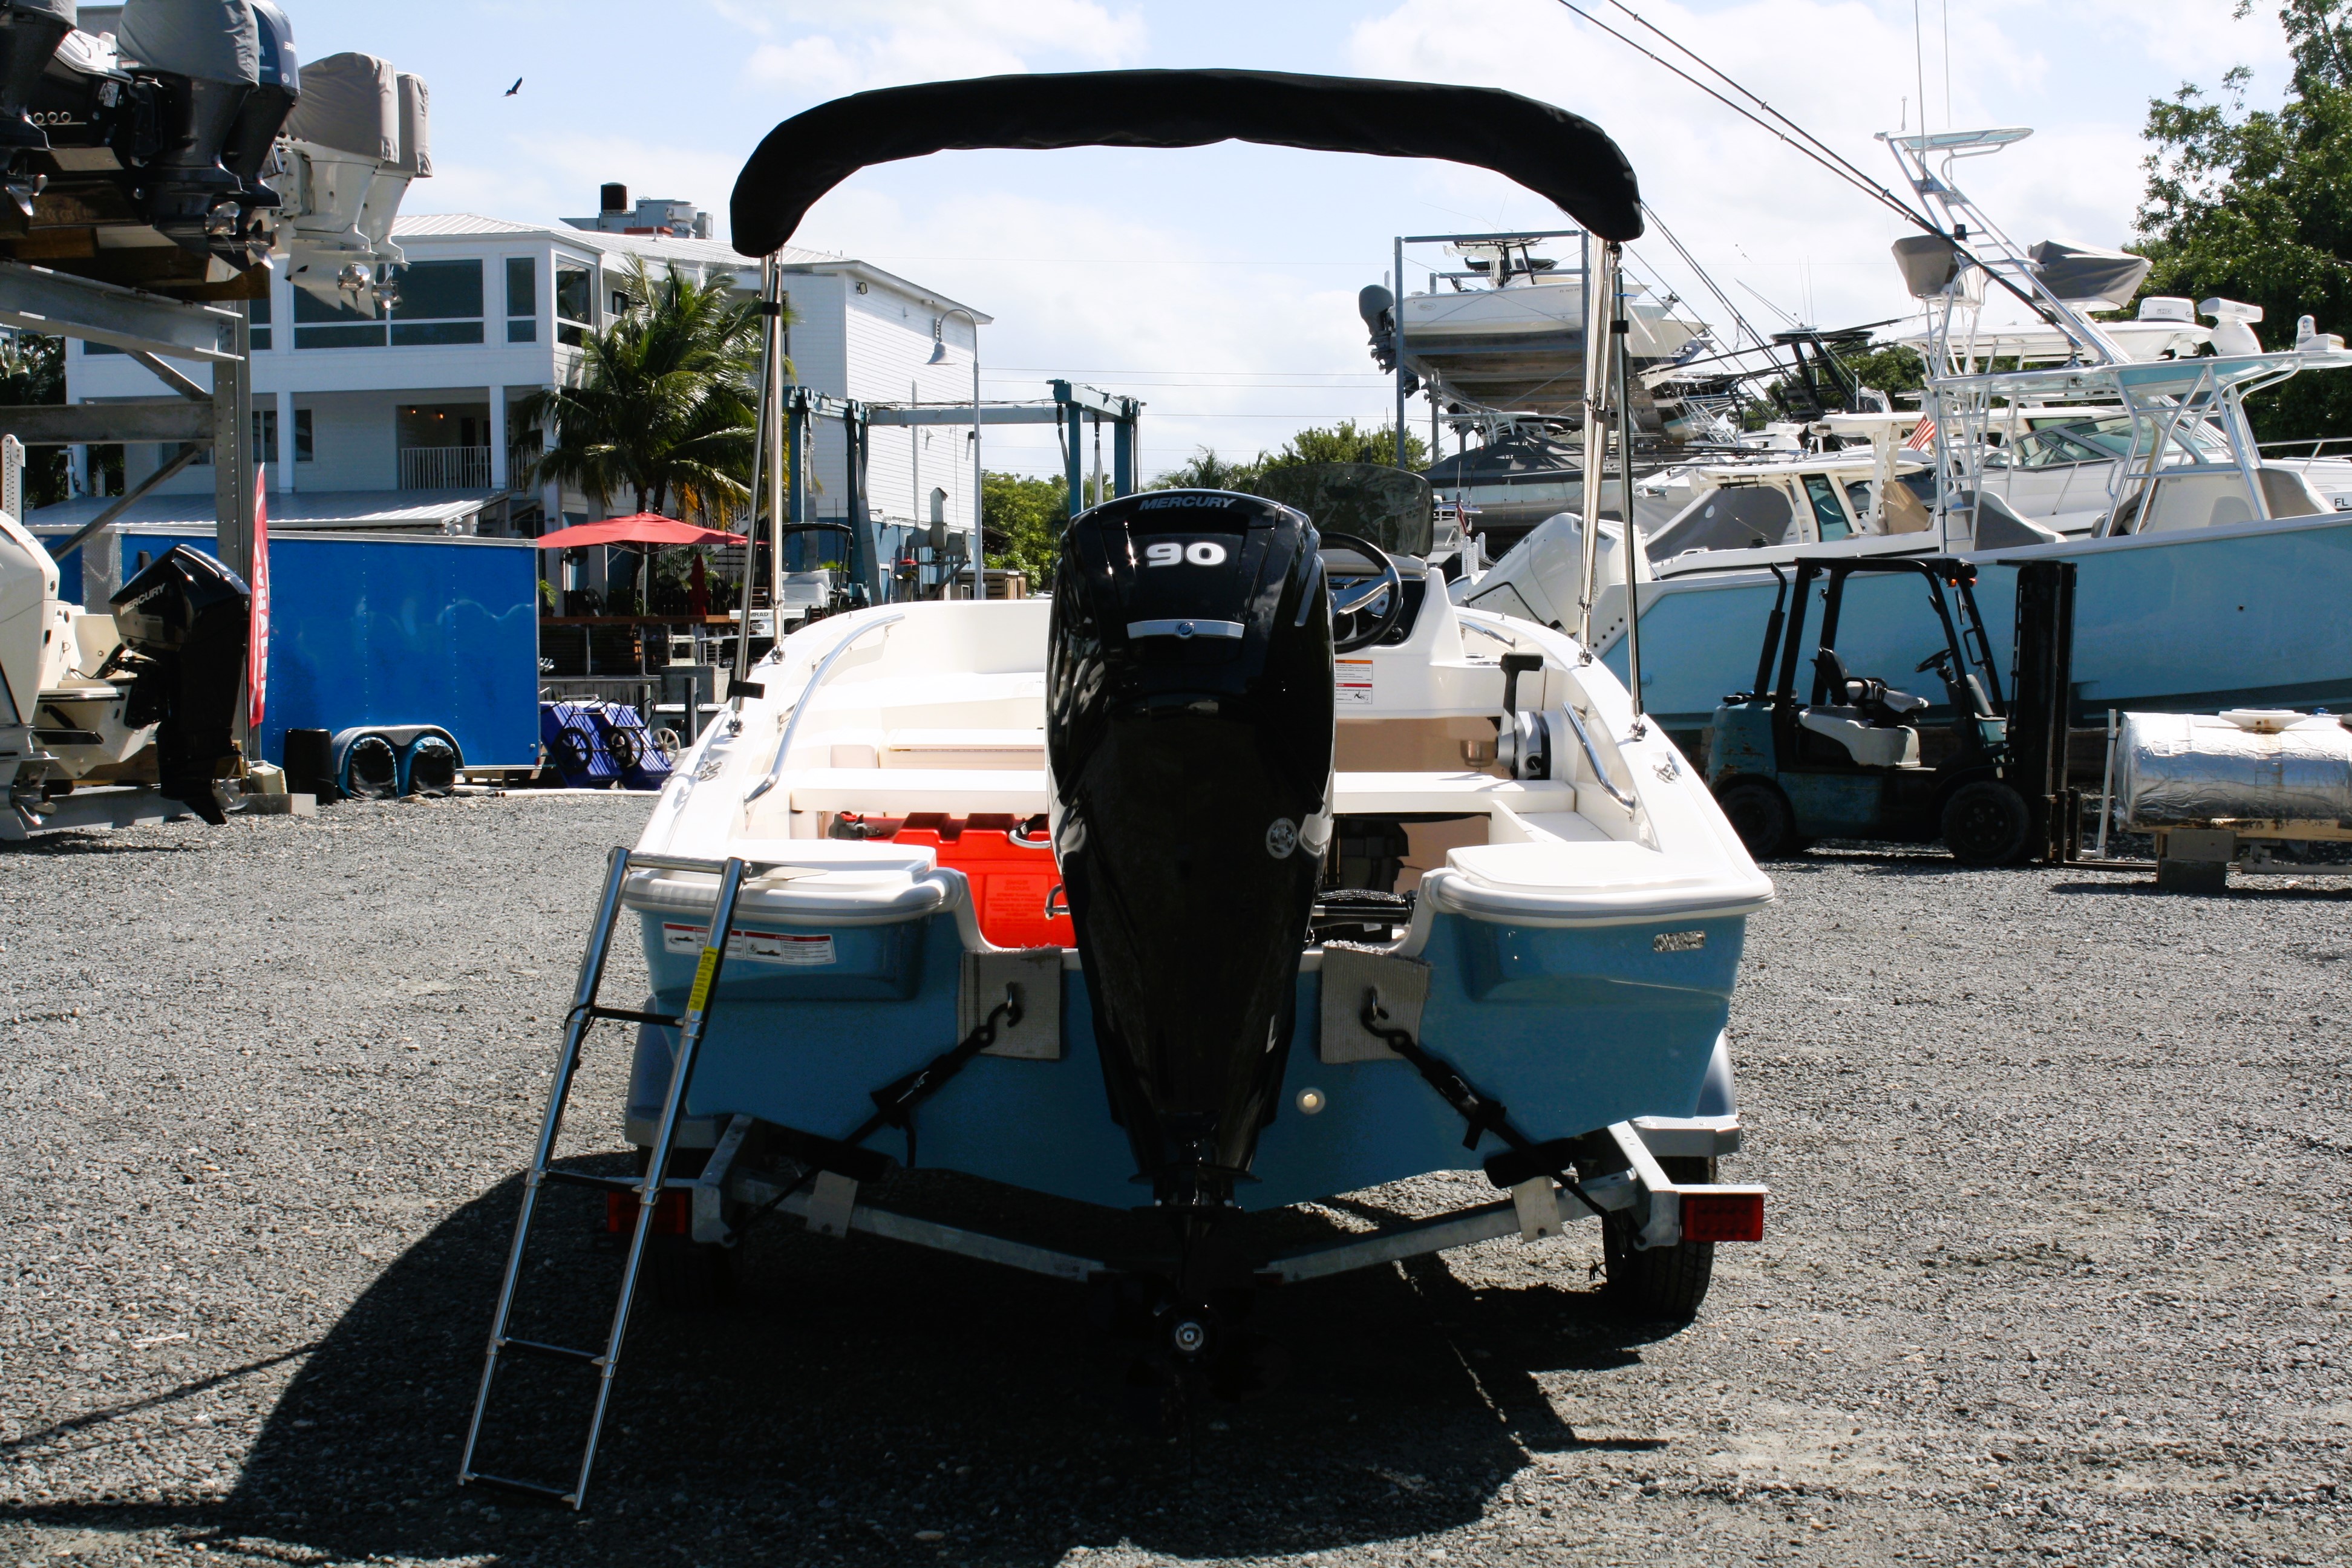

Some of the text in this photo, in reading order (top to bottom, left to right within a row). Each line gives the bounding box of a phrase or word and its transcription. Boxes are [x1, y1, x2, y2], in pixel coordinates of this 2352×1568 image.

[1138, 495, 1236, 511] MERCURY
[2334, 498, 2348, 506] FL
[1145, 541, 1227, 568] 90
[120, 583, 166, 616] MERCURY
